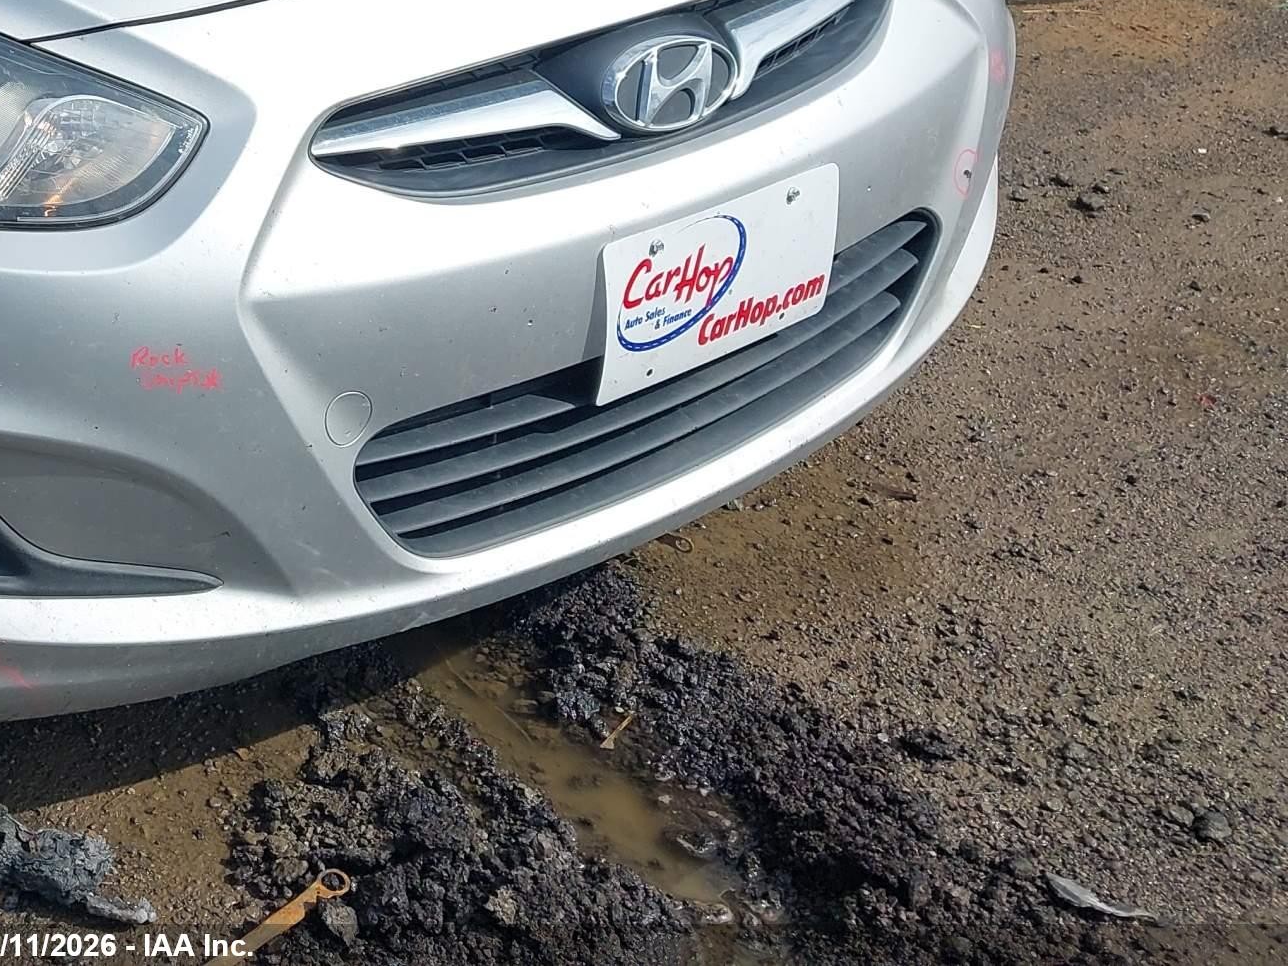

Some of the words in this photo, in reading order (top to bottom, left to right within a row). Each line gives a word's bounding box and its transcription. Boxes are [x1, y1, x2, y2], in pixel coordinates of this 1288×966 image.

[622, 243, 734, 310] CarHop
[624, 315, 643, 331] Auto
[645, 306, 666, 321] Sales
[654, 320, 661, 330] &
[662, 308, 693, 327] Finance
[697, 274, 826, 346] CarHop.com
